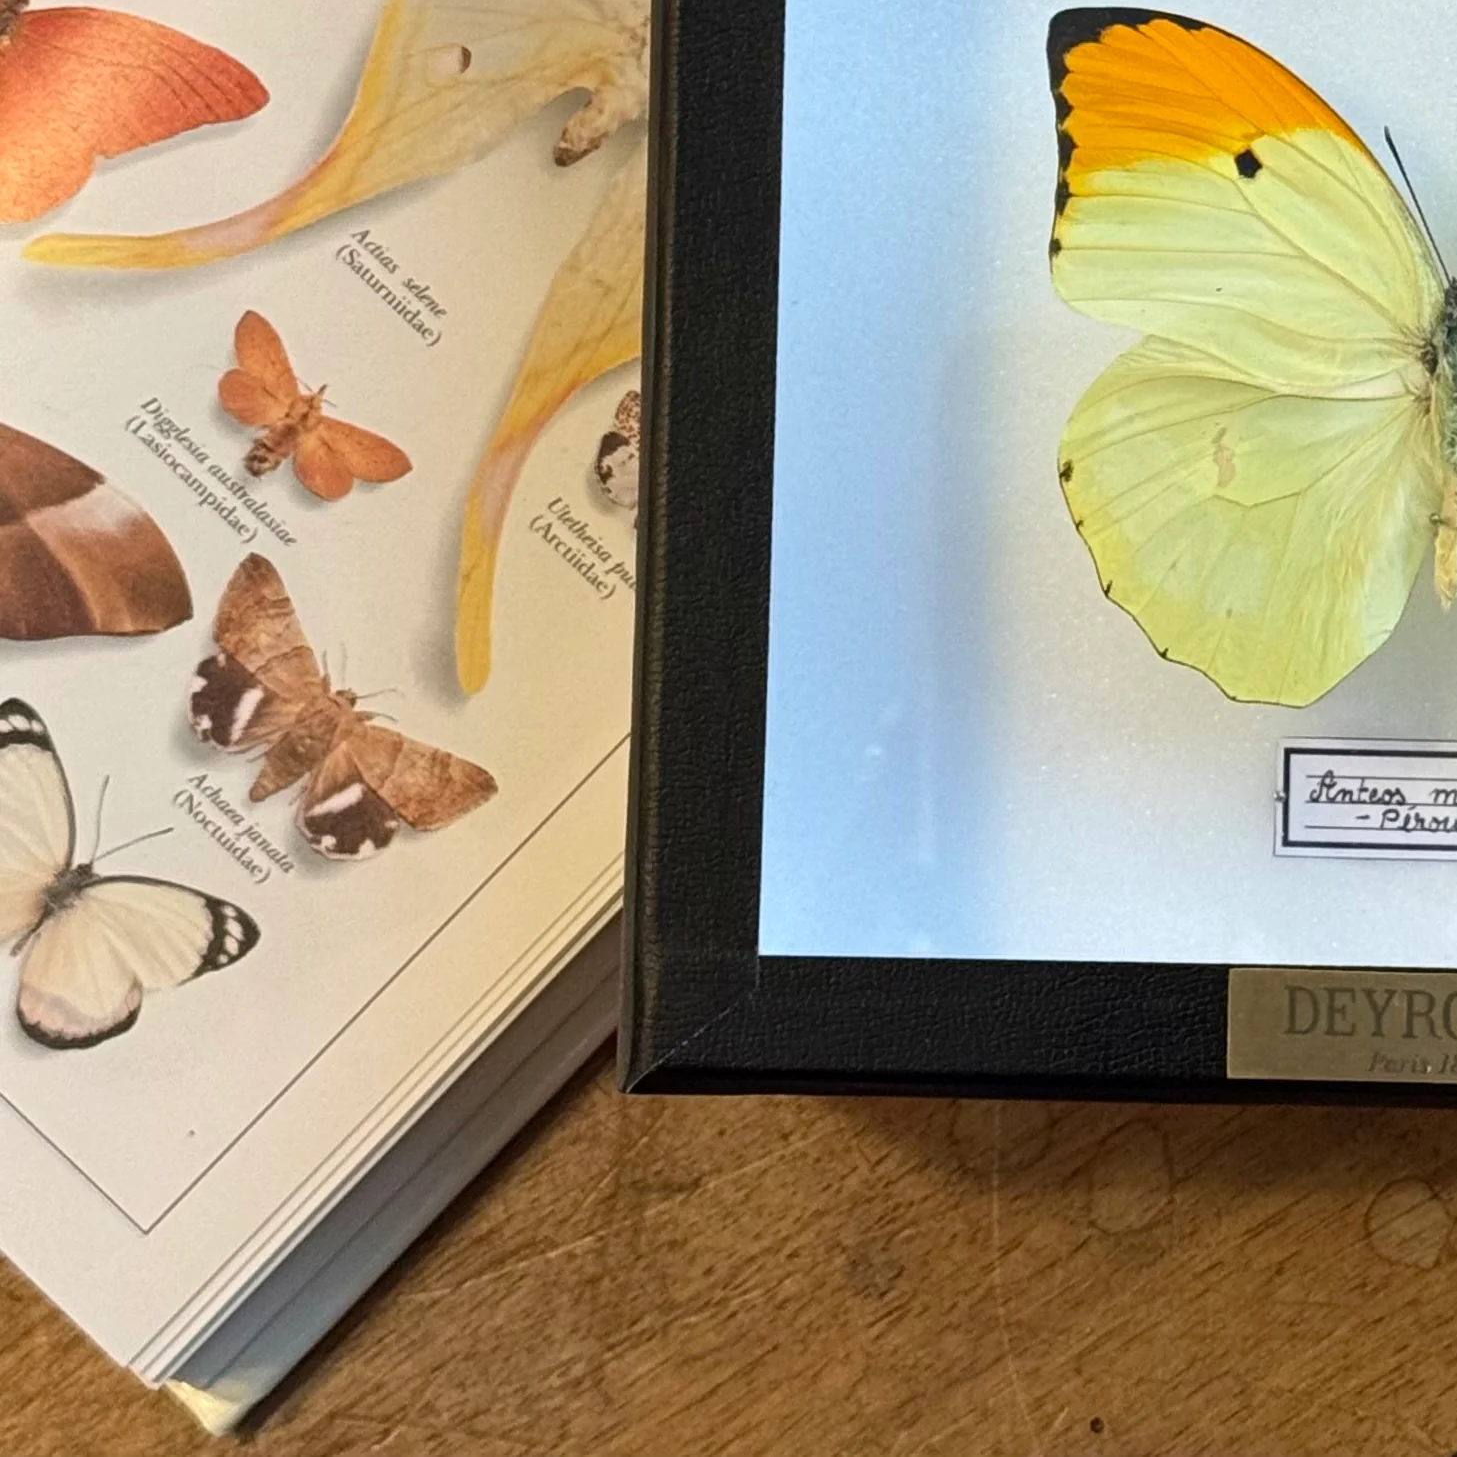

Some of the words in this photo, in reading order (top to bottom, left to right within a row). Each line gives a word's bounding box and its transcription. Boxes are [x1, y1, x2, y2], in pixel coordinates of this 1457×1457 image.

[336, 244, 442, 347] (Saturniidae)
[350, 229, 400, 274] Actias
[402, 277, 447, 319] selene
[125, 416, 258, 544] (Lasiocampidae)
[140, 397, 210, 464] Digglesia
[207, 463, 297, 546] australasiae
[529, 515, 616, 600] (Arctiidae)
[547, 497, 613, 563] Utetheisa
[187, 774, 245, 825] Achaea
[234, 823, 295, 873] janata
[1309, 770, 1406, 805] Anteos
[173, 789, 271, 884] (Noctuidae)
[1368, 1051, 1430, 1074] Paris
